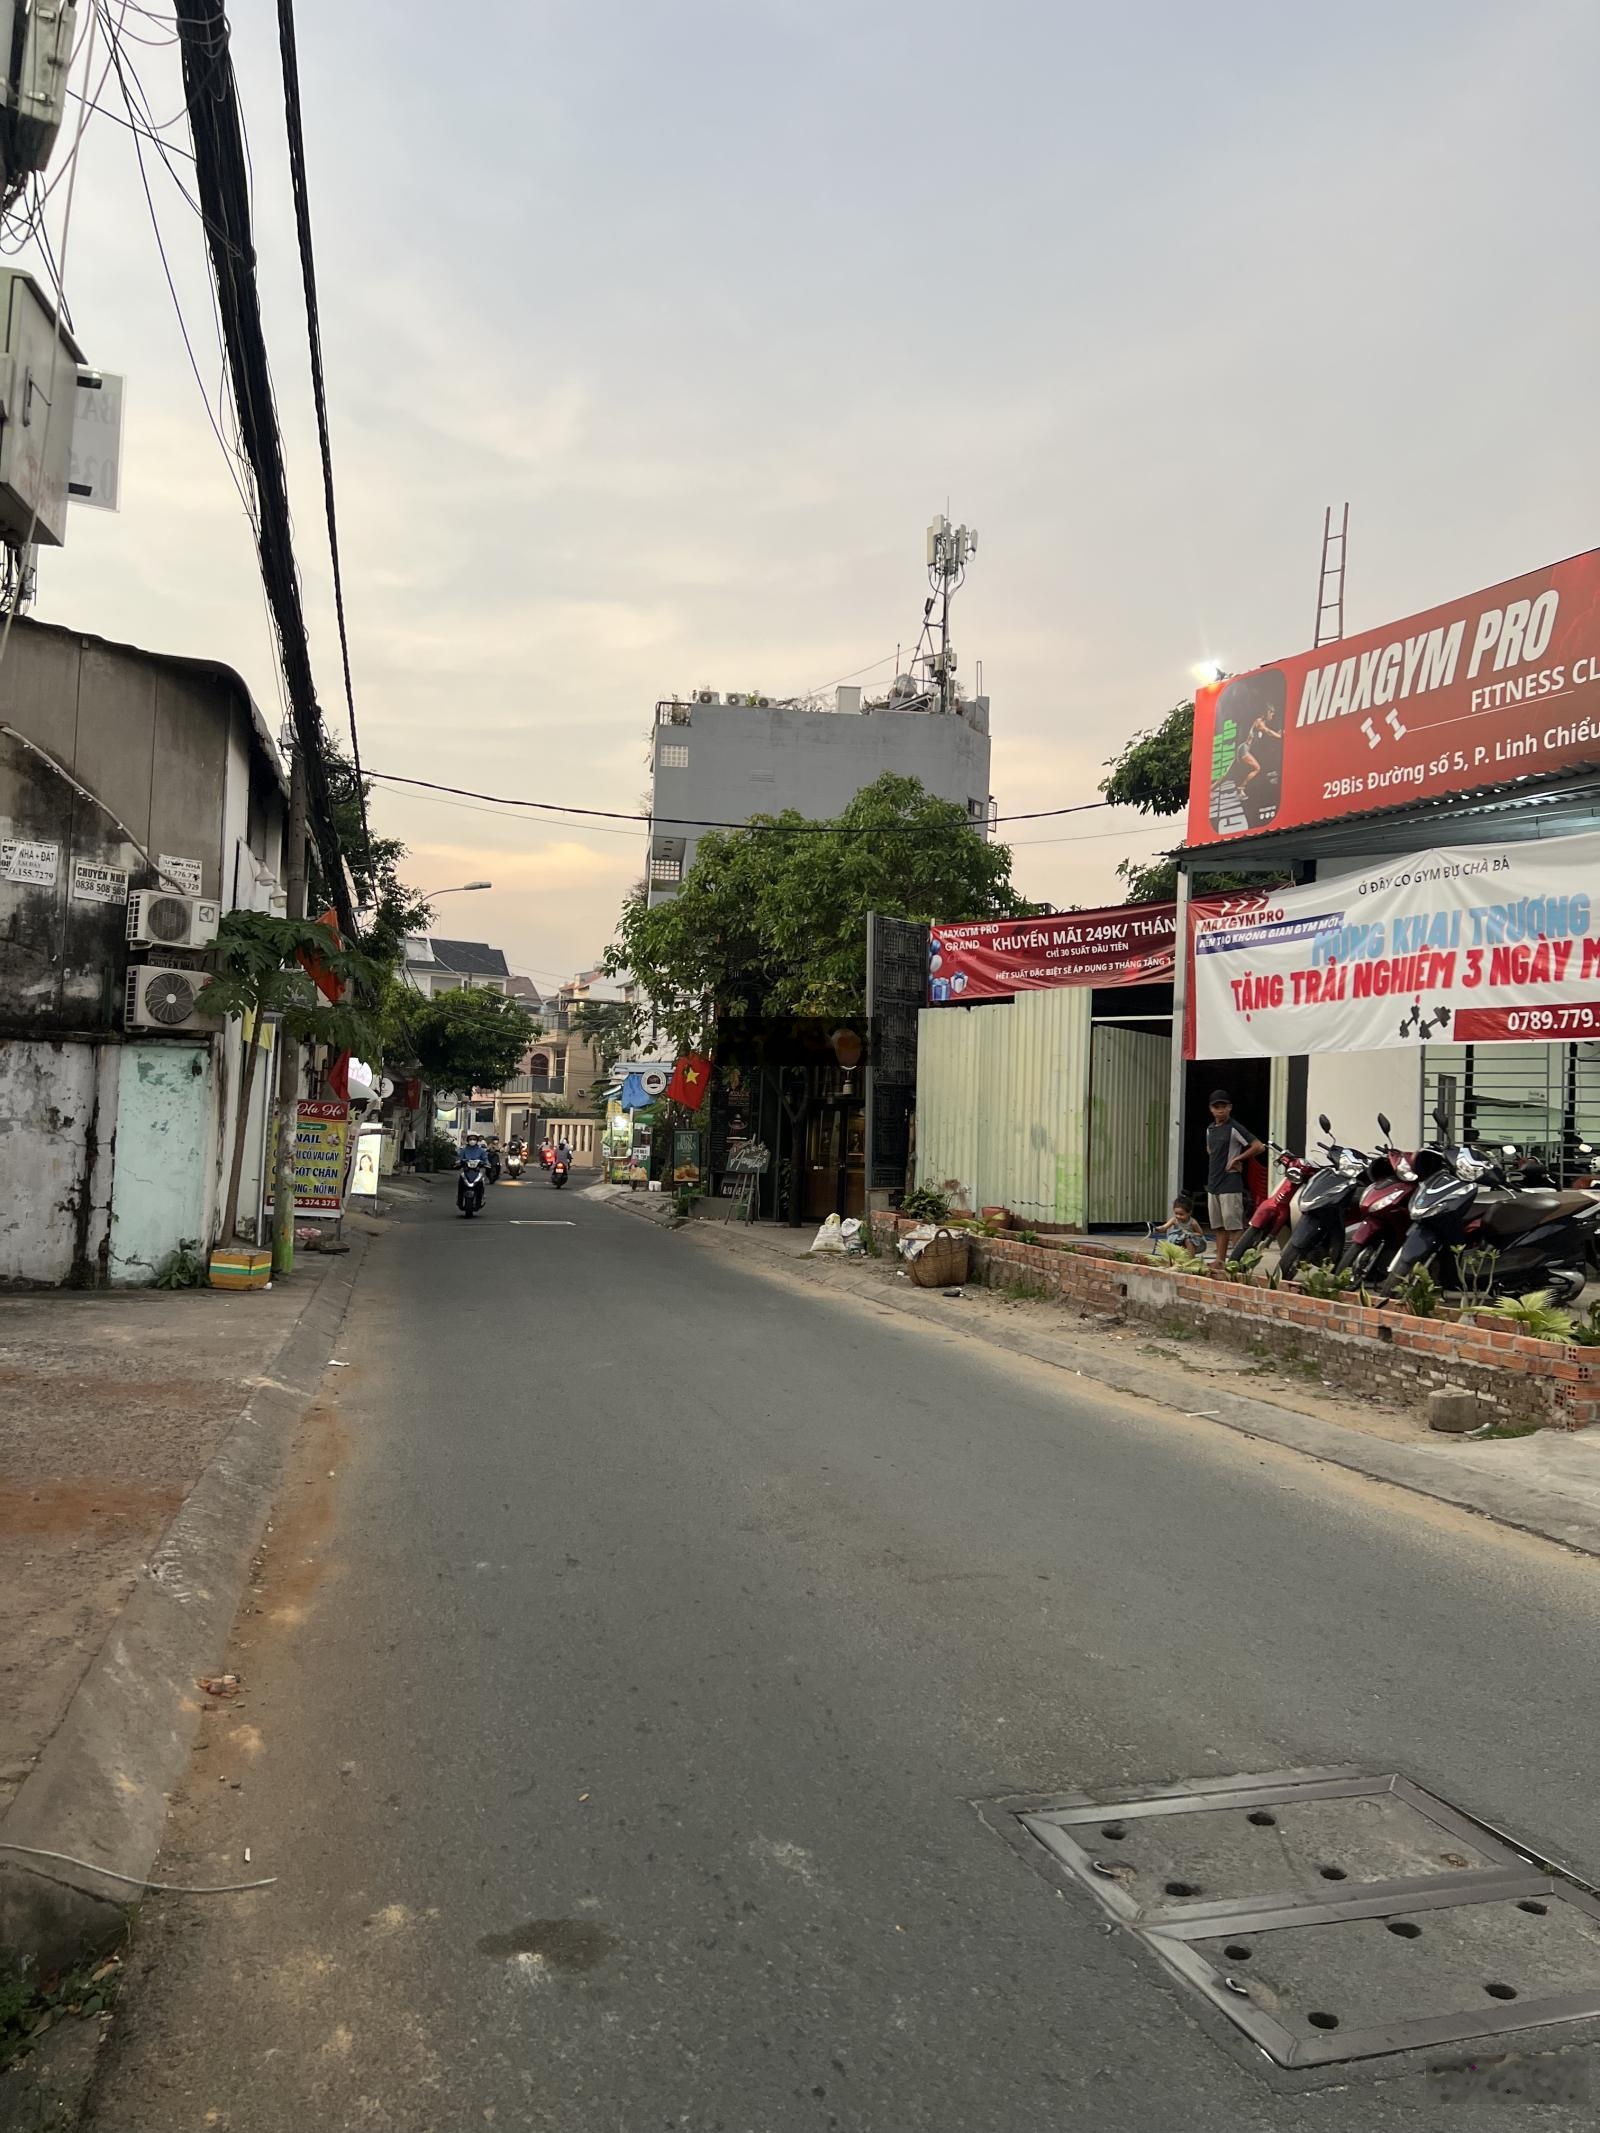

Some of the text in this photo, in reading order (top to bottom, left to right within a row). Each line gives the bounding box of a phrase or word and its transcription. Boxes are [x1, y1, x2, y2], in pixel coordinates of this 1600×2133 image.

[1296, 589, 1560, 728] MAXGYM PRO
[1471, 656, 1600, 712] FITNESS CL
[1322, 716, 1600, 799] 29Bis Đường số 5, P. Linh Chiểu
[1370, 876, 1393, 893] ĐÂY
[1413, 867, 1441, 883] GYM
[1462, 857, 1489, 876] CHÀ
[1492, 854, 1510, 871] BÁ
[939, 924, 1000, 940] MAXGYM PRO
[1201, 908, 1285, 932] MAXGYM PRO
[1267, 925, 1294, 939] GIAN
[1293, 921, 1317, 934] GYM
[1392, 909, 1463, 956] KHAI
[944, 940, 980, 952] GRAND
[992, 928, 1049, 952] KHUYẾN
[1053, 926, 1083, 945] MÃI
[1085, 923, 1129, 942] 249K/
[1061, 949, 1069, 957] 30
[1108, 962, 1113, 971] 3
[1115, 959, 1142, 970] THÁNG
[1230, 971, 1284, 1023] TẶNG
[1289, 955, 1348, 1005] TRẢI
[1352, 944, 1457, 1005] NGHIỆM
[1462, 949, 1484, 988] 3
[1489, 932, 1573, 986] NGÀY
